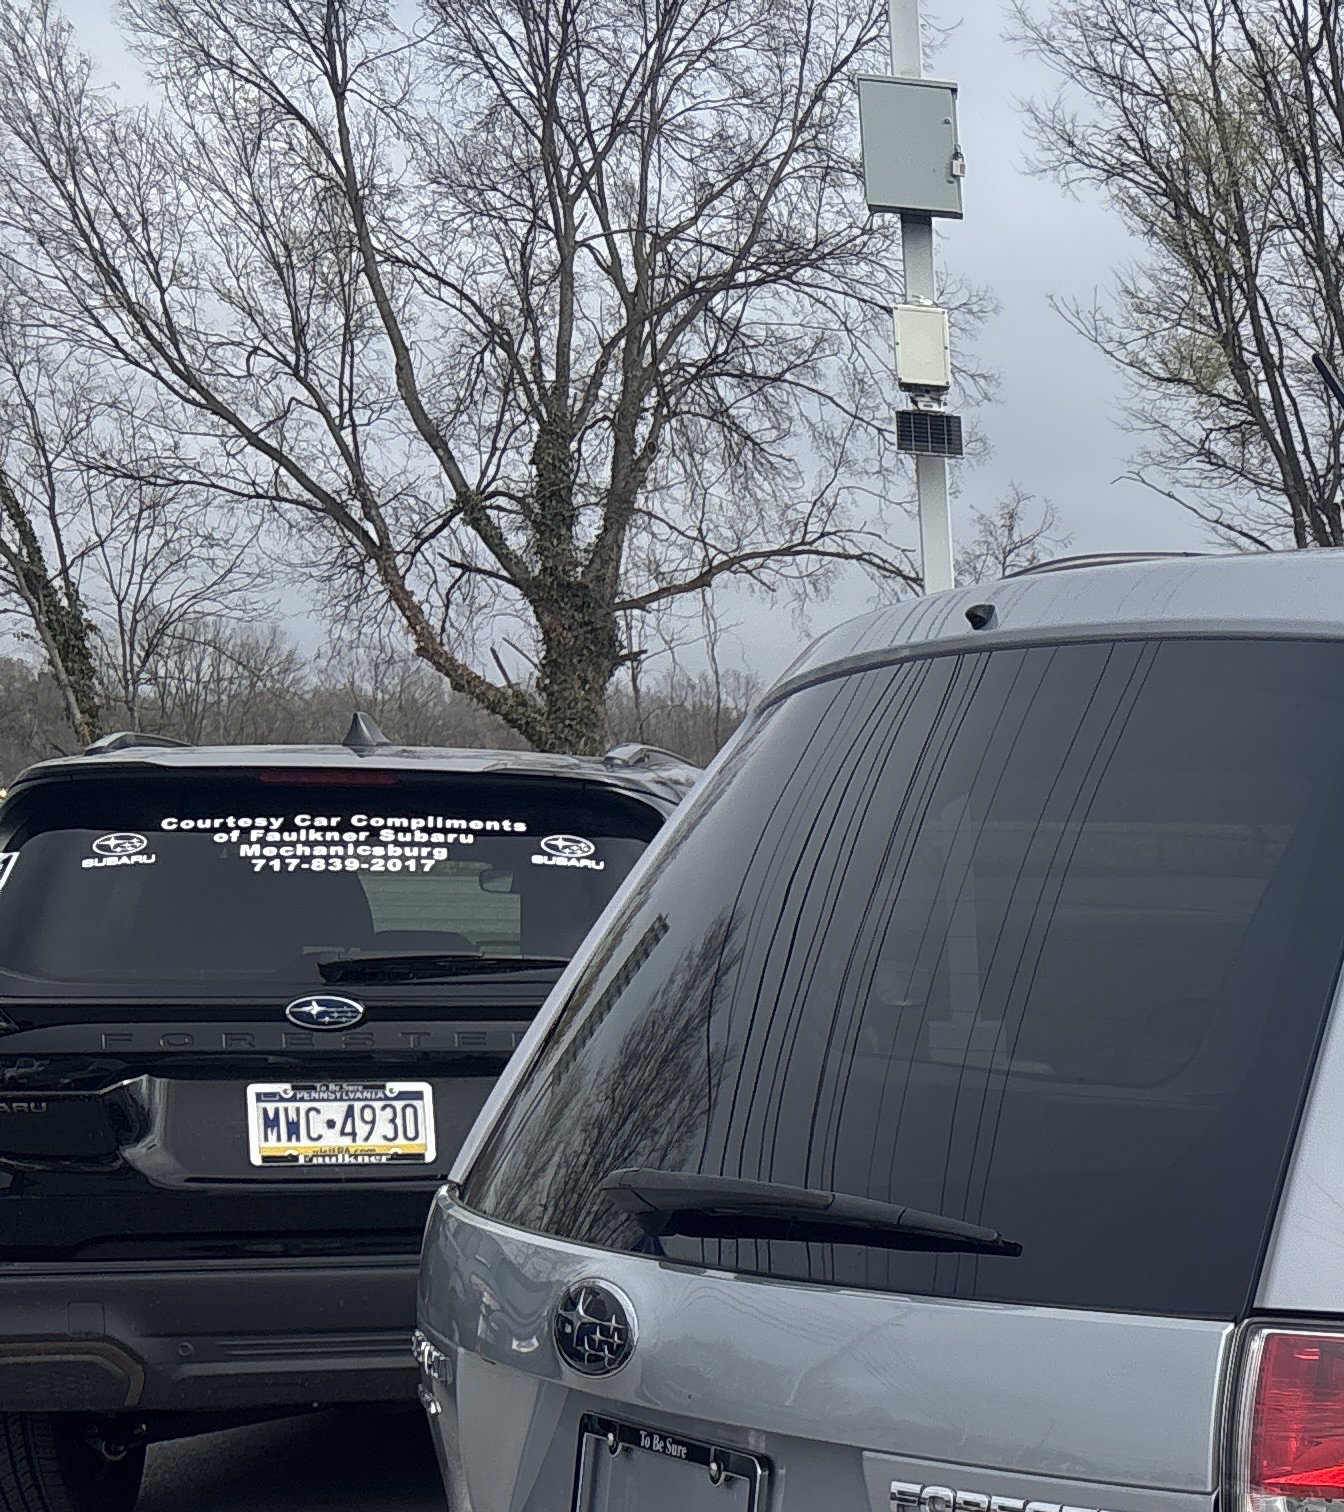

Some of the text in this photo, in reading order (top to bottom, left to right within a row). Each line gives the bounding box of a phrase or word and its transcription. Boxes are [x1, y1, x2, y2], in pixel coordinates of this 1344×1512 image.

[161, 814, 527, 832] Courtesy Car Compliments
[213, 829, 474, 844] of Faulkner Subaru
[239, 843, 448, 860] Mechanicsburg
[82, 854, 155, 867] SUBARU
[251, 858, 435, 872] 717-839-2017
[532, 855, 604, 870] SUBARU
[101, 1031, 523, 1050] FORESTE
[296, 1091, 385, 1100] PENNSYLVANIA
[639, 1430, 688, 1459] To Be Sure
